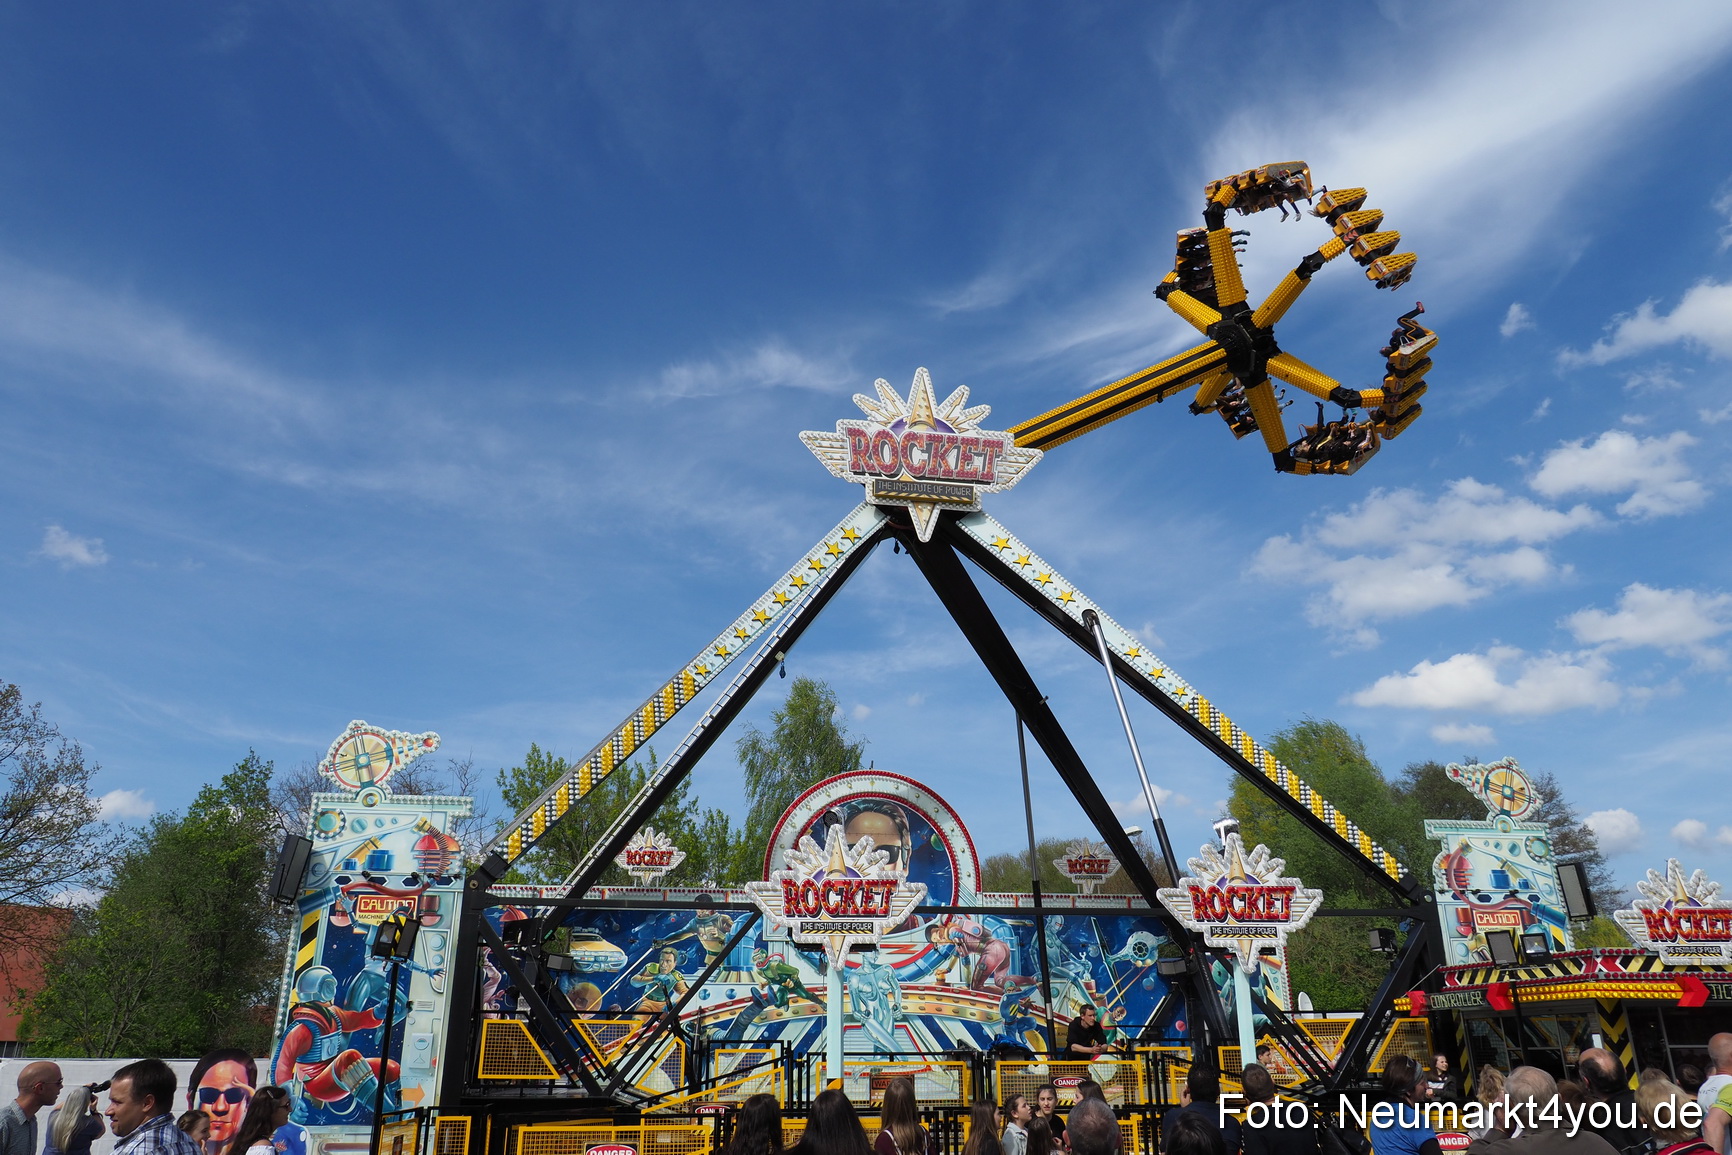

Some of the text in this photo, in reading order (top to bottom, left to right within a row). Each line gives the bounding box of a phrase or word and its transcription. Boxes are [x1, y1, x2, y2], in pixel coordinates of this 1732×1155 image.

[847, 427, 1004, 481] ROCKET
[878, 481, 971, 496] THE INSTITUTE OF POWER
[626, 850, 673, 865] ROCKET
[1067, 859, 1110, 873] ROCKET
[781, 879, 898, 915] ROCKET
[1188, 885, 1296, 920] ROCKET
[1476, 913, 1519, 924] CAUTION
[1640, 908, 1732, 940] ROCKET
[802, 922, 873, 931] THE INSTITUTE OF POWER
[1211, 926, 1276, 935] THE INSTITUTE OF POWER
[1429, 990, 1484, 1009] CONTROLLER
[1438, 1137, 1470, 1146] ANGER
